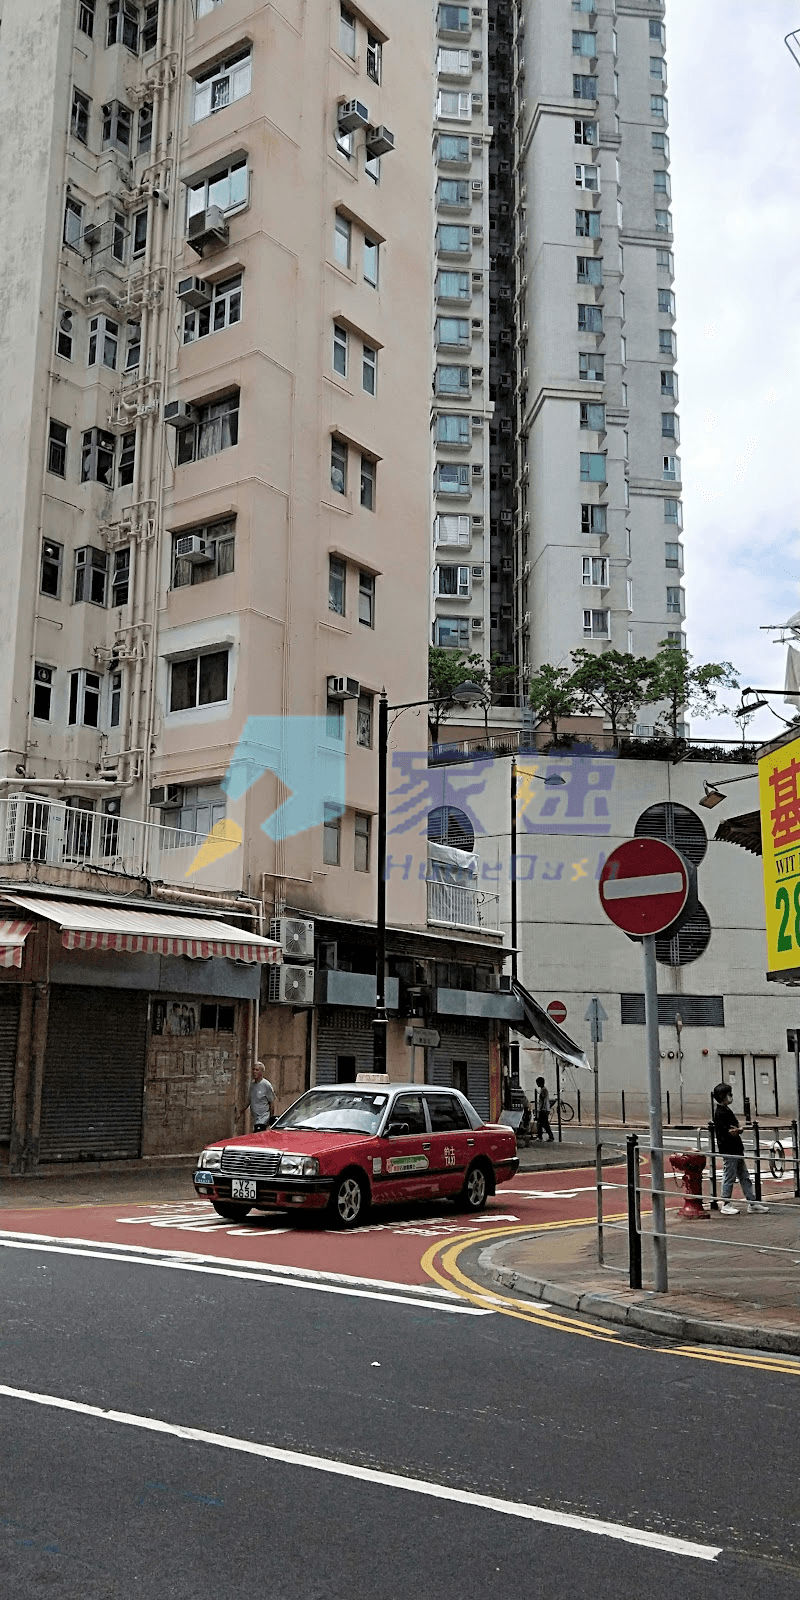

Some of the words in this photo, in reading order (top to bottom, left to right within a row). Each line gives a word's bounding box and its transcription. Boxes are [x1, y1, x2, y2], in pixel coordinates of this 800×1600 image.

[769, 758, 800, 848] 基
[776, 854, 796, 876] WIT
[444, 1146, 455, 1155] 的士
[445, 1156, 455, 1166] TAXI
[233, 1189, 256, 1198] 2630
